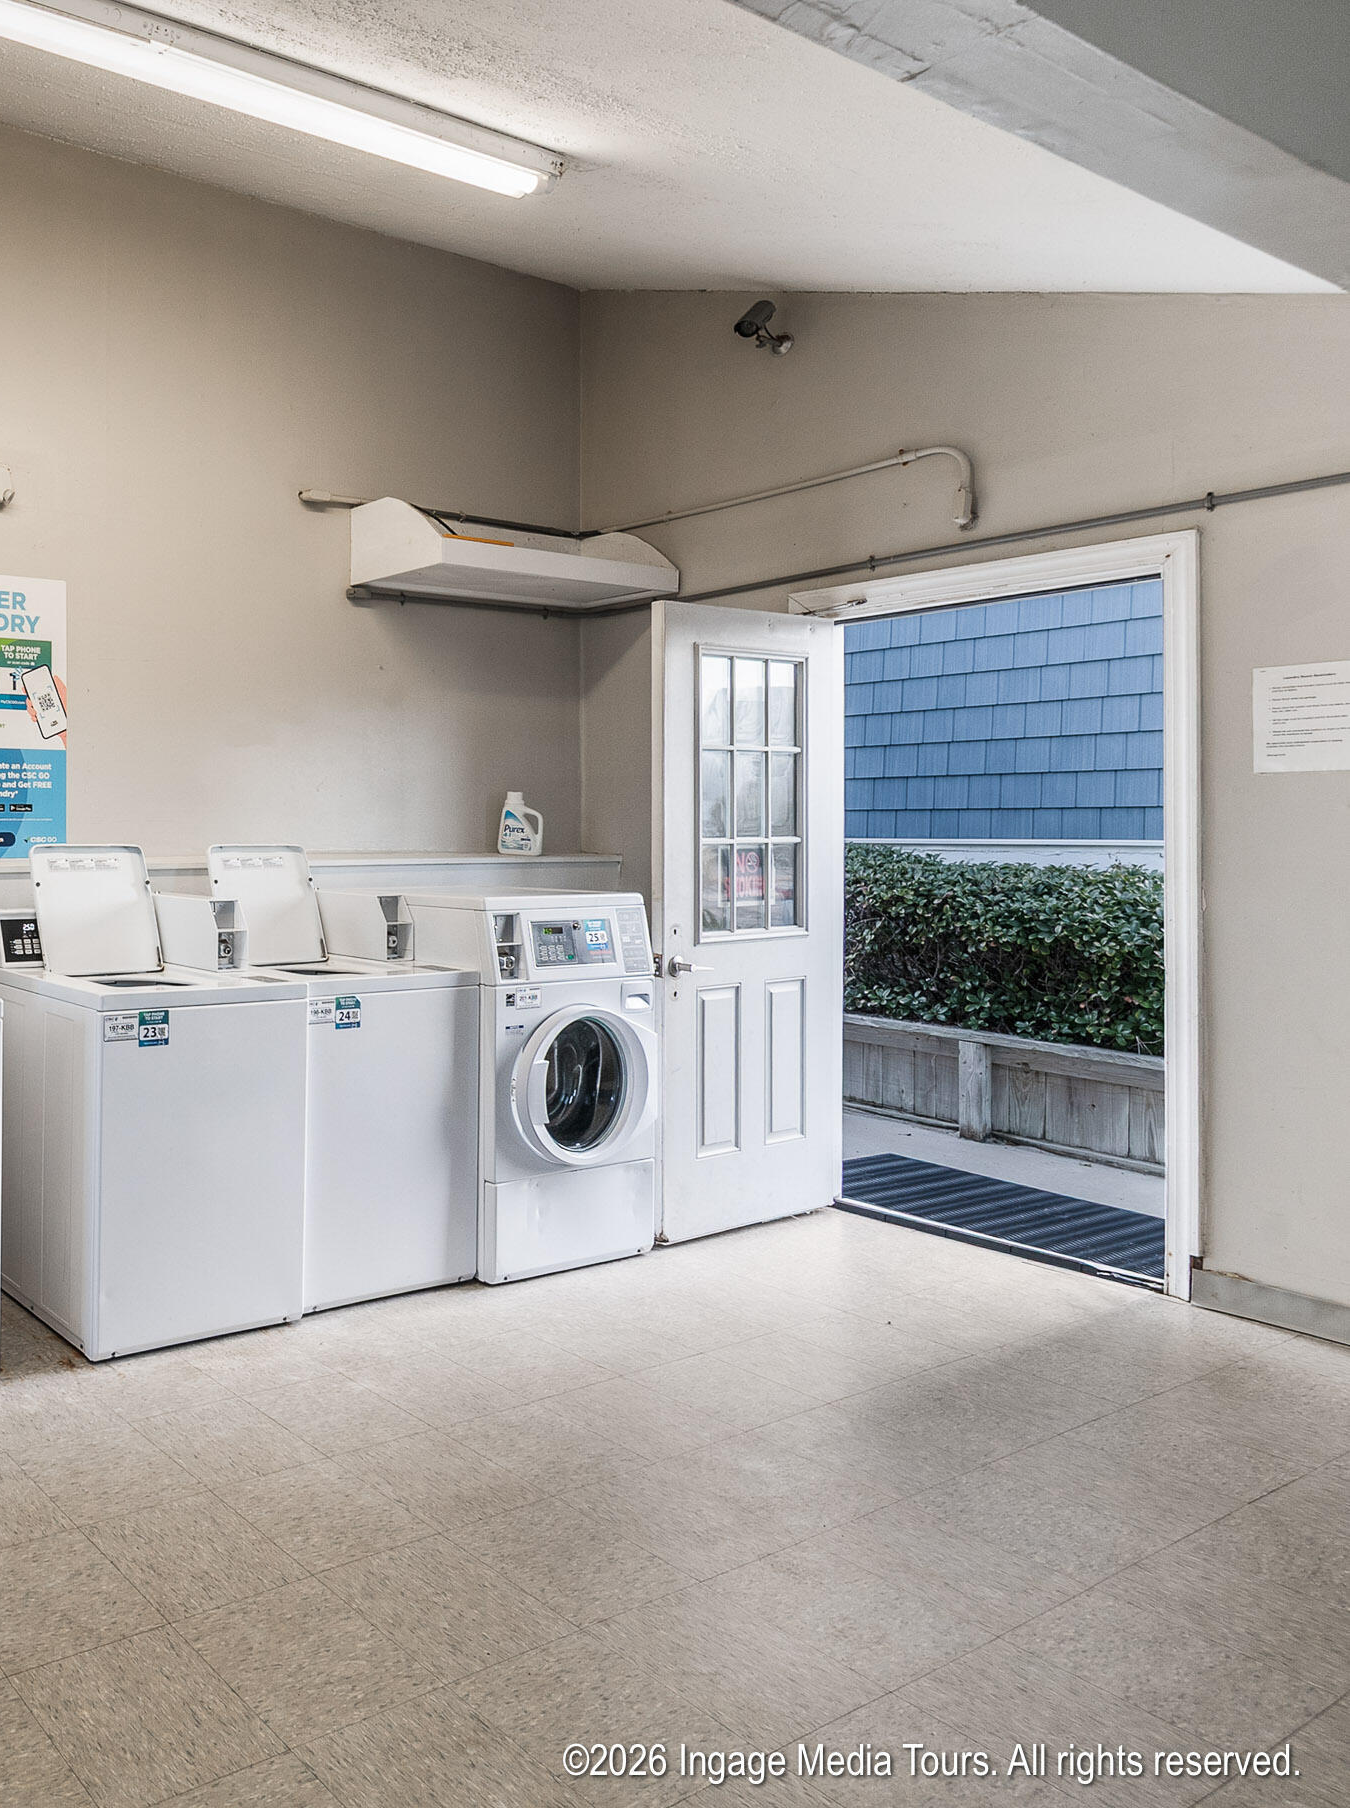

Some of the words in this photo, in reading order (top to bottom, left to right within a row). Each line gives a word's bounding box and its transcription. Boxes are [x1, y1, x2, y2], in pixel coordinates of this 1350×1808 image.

[16, 646, 41, 654] PHONE
[8, 771, 20, 779] the
[504, 824, 524, 833] Purex
[737, 851, 759, 873] NO
[589, 933, 599, 942] 25
[339, 1011, 350, 1021] 24
[143, 1027, 156, 1038] 23
